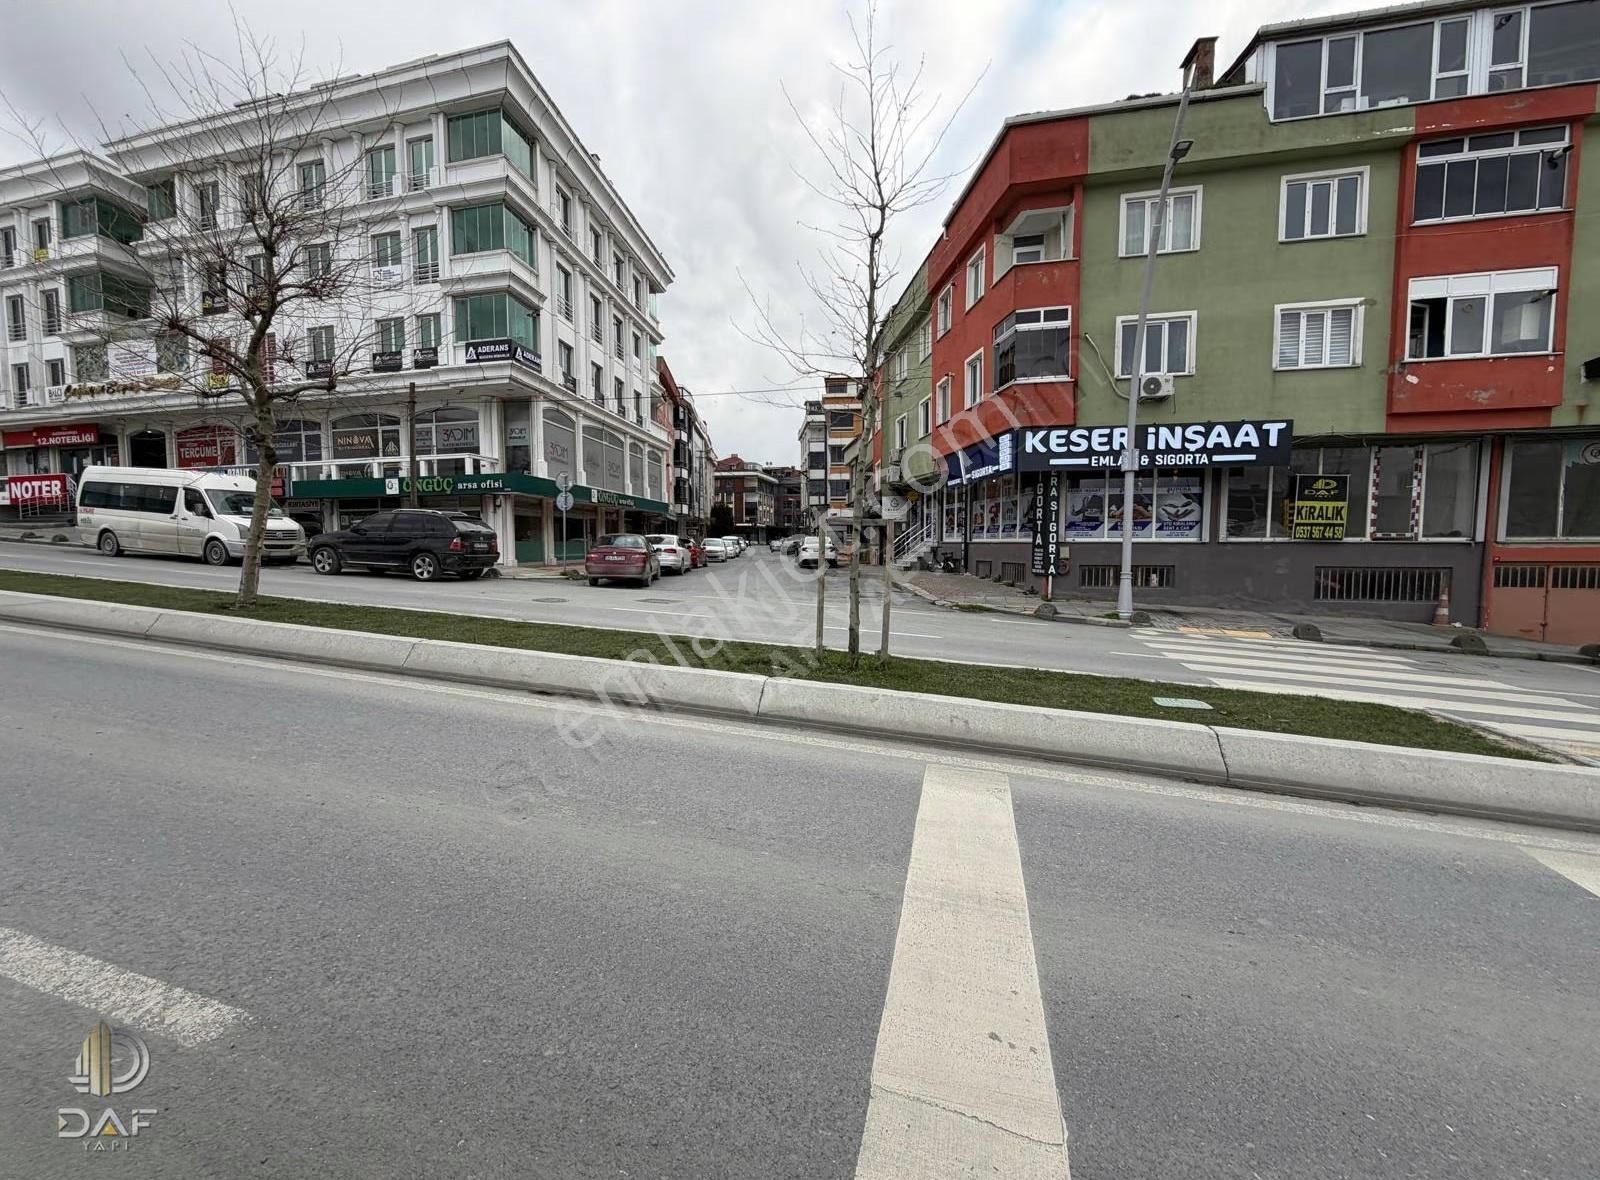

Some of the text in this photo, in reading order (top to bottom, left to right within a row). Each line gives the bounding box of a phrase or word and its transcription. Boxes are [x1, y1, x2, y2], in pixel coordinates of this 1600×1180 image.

[478, 344, 509, 354] ADERANS
[1025, 426, 1129, 453] KESER
[179, 445, 217, 459] TERCÜME
[1091, 455, 1123, 467] EML
[1140, 454, 1150, 466] &
[10, 480, 62, 500] NOTER
[457, 481, 478, 490] arsa
[1296, 526, 1311, 539] 0537
